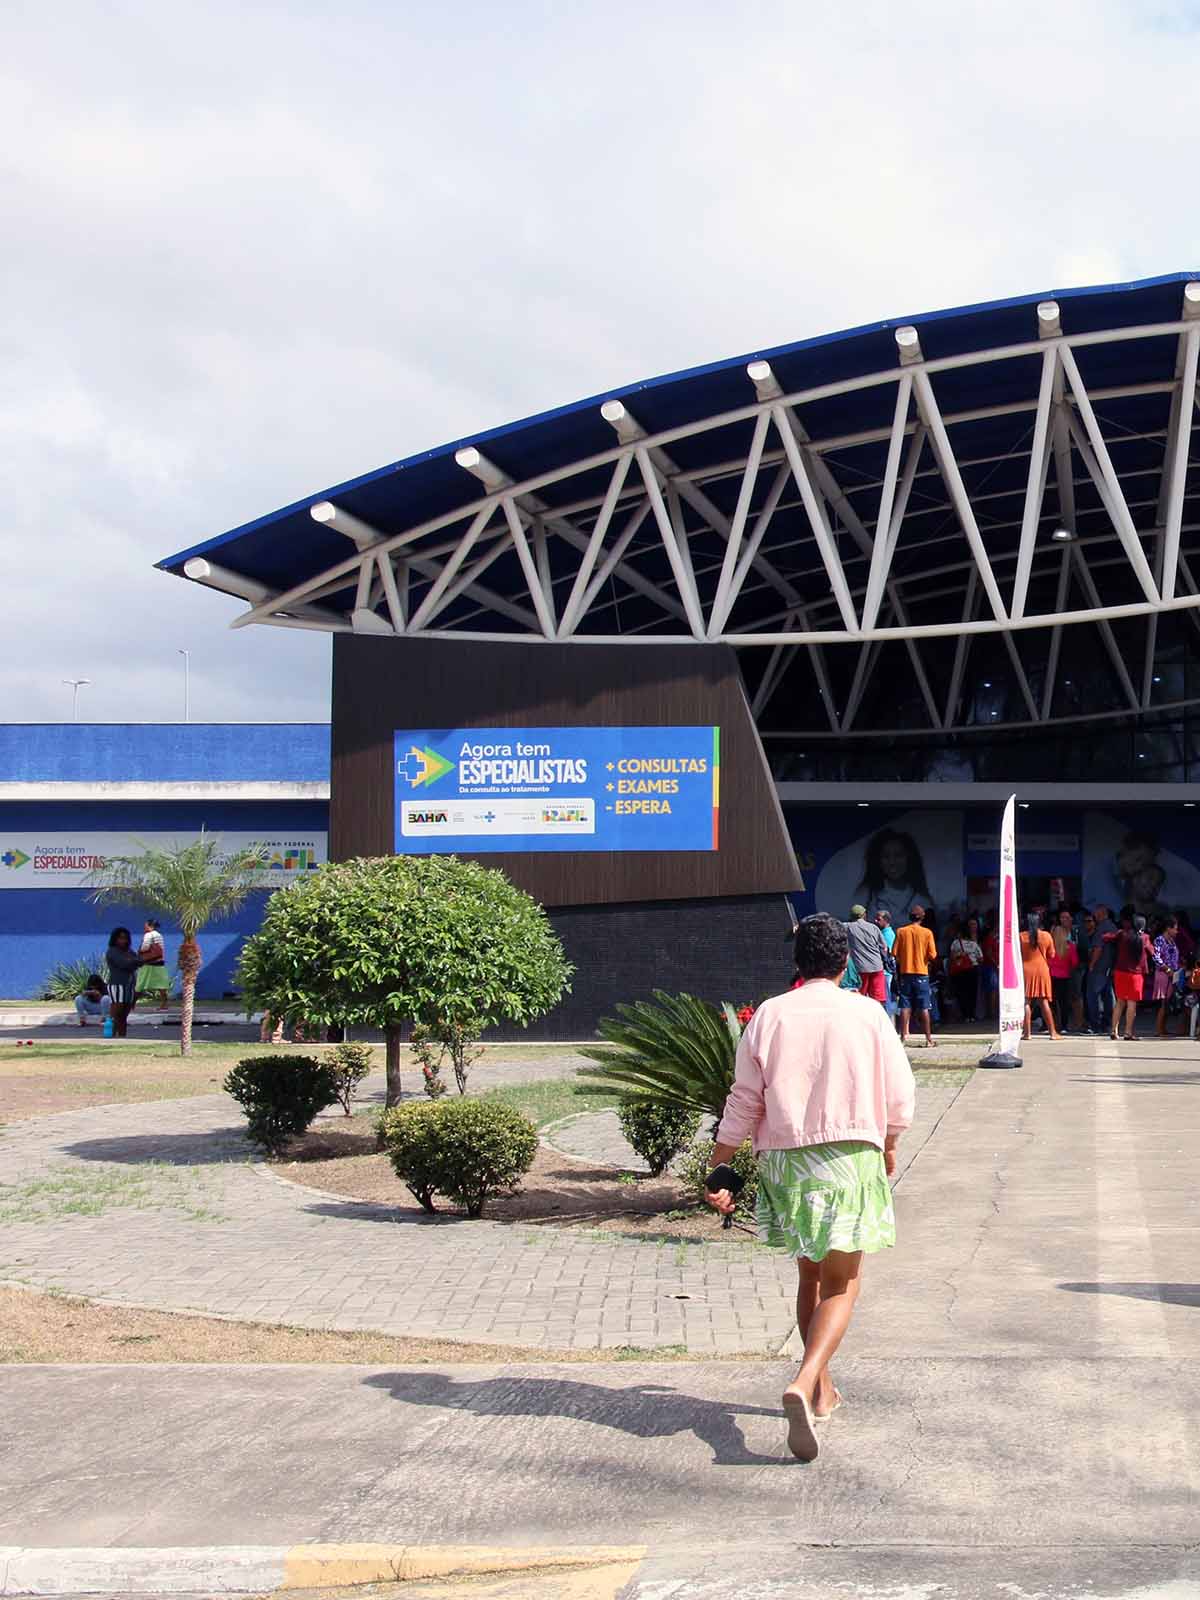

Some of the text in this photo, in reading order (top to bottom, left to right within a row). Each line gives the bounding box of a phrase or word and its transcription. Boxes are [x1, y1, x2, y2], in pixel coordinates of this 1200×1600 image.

[460, 742, 551, 760] Agora tem
[459, 759, 588, 785] ESPECIALISTAS
[618, 758, 707, 774] CONSULTAS
[618, 779, 680, 794] EXAMES
[614, 799, 672, 815] ESPERA
[408, 813, 448, 823] BAHIA
[34, 845, 86, 855] Agora tem
[33, 855, 106, 870] ESPECIALISTAS
